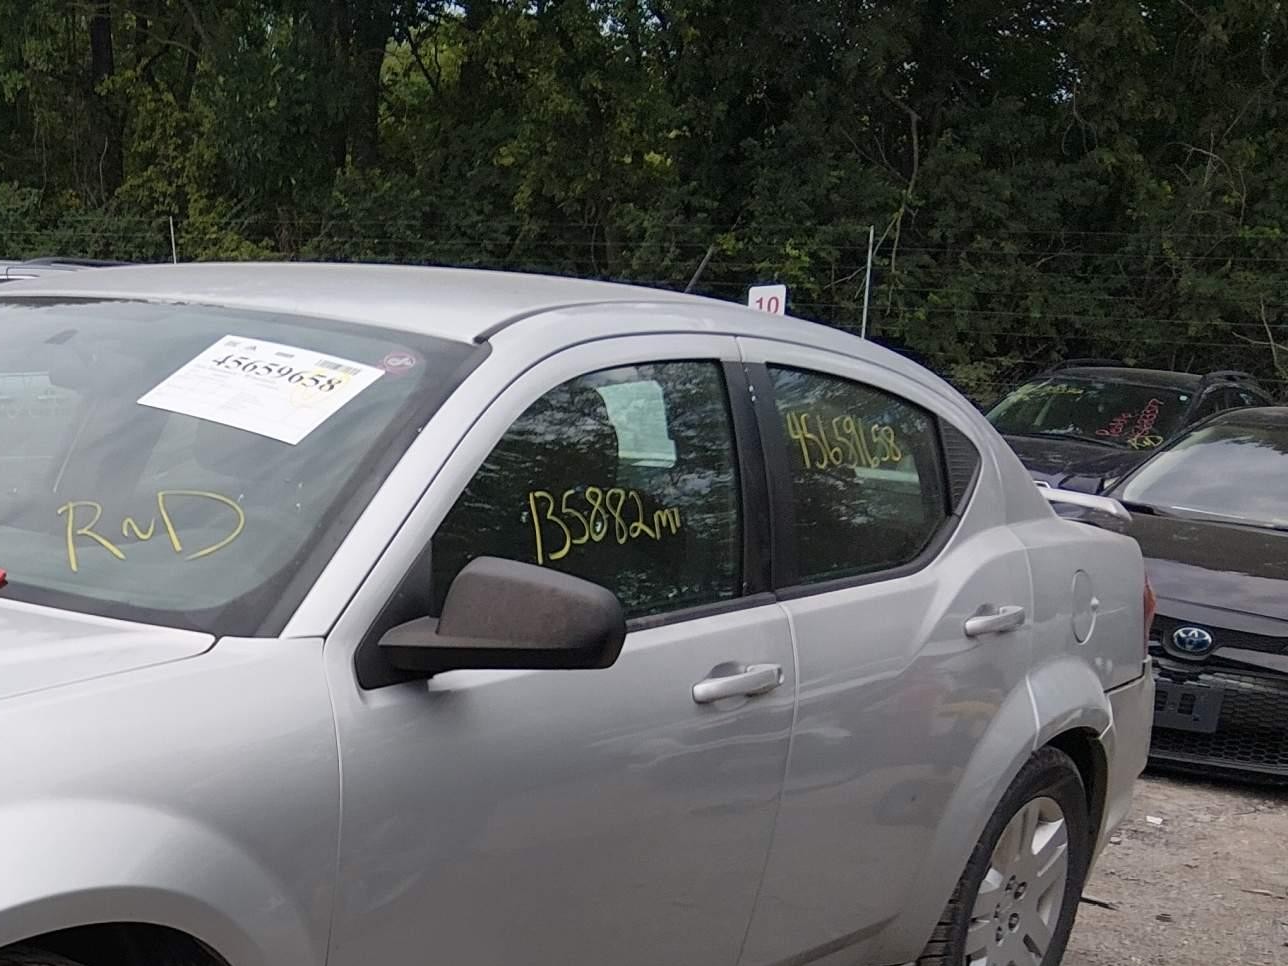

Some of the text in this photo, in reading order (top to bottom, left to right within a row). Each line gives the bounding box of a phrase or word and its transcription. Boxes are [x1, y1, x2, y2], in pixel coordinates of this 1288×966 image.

[755, 296, 780, 314] 10
[212, 354, 342, 393] 45659658
[786, 411, 902, 470] 45659658
